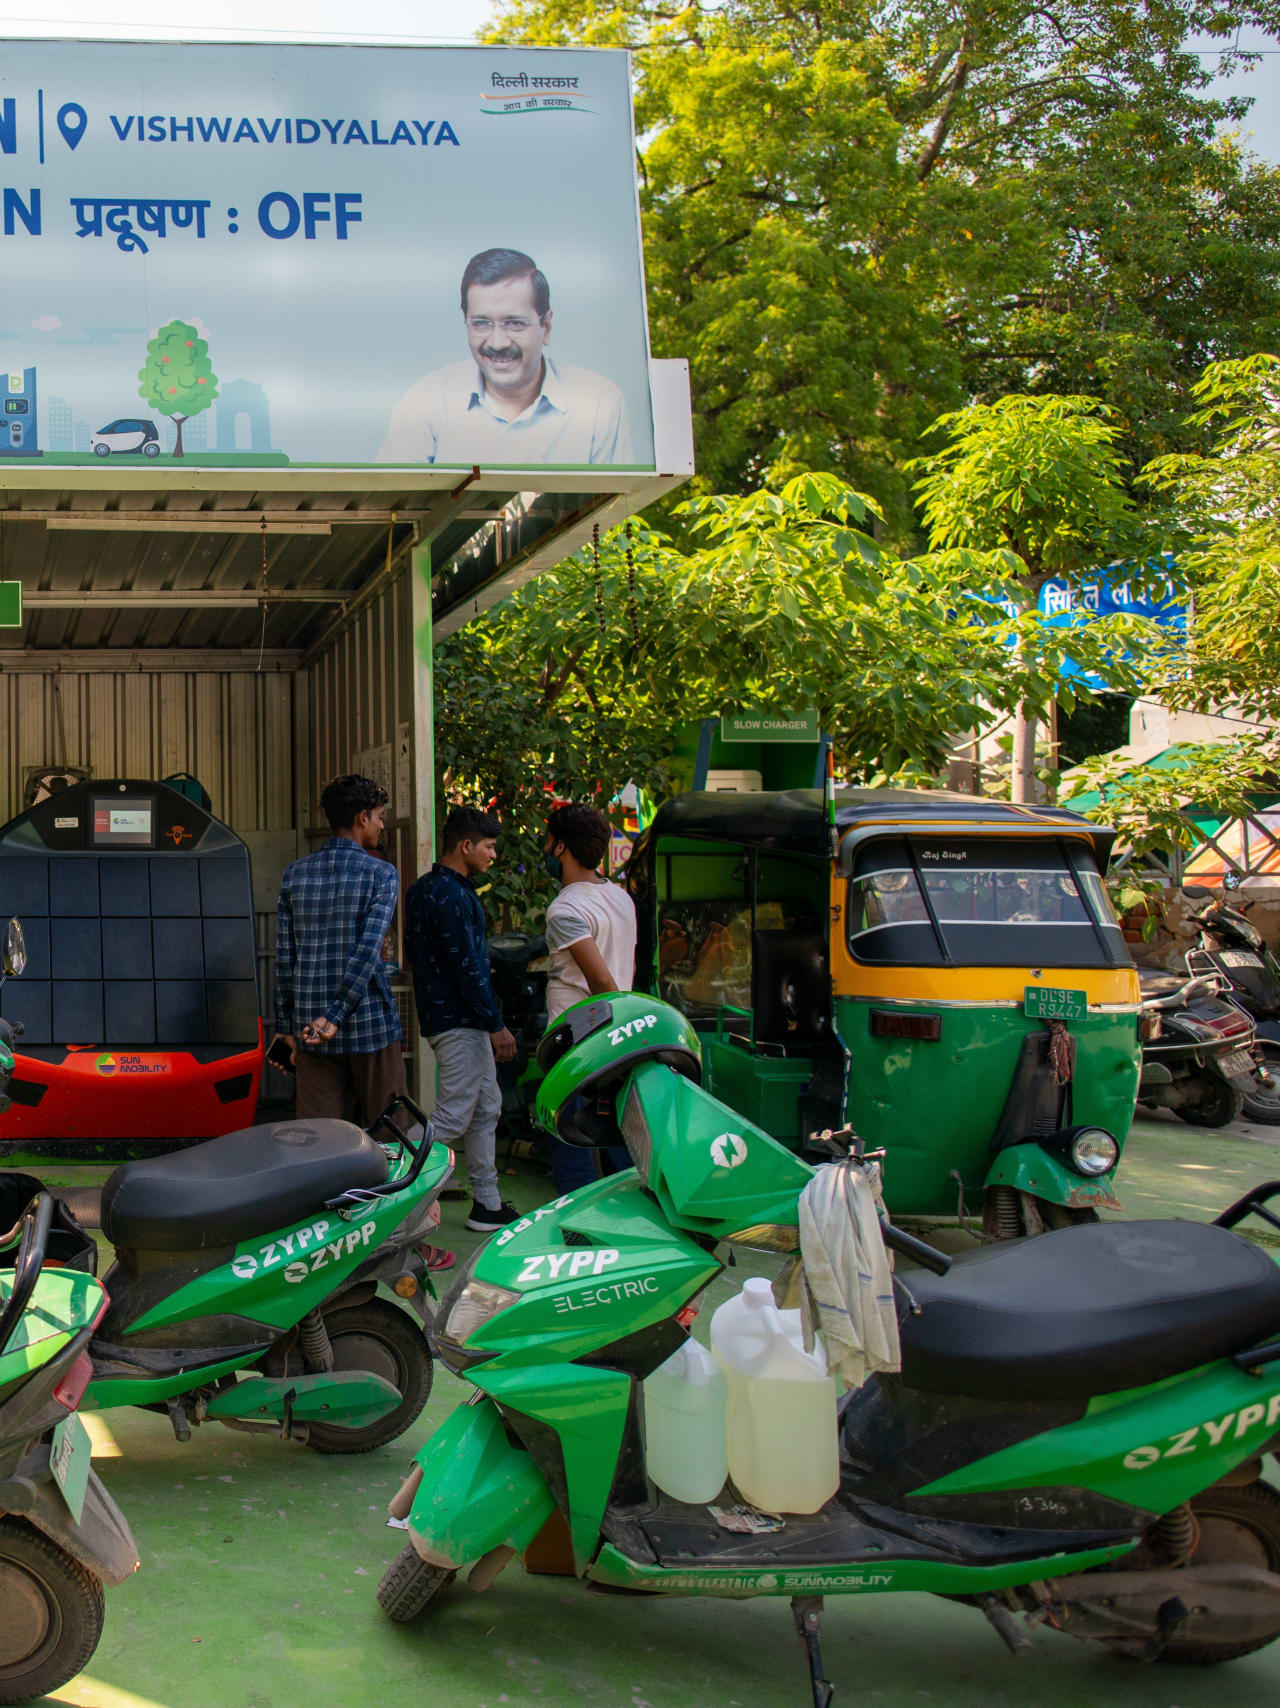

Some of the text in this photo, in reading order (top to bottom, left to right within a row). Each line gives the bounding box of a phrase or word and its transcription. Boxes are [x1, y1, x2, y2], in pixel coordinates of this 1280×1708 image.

[491, 72, 579, 88] दिल्ली सरकार
[110, 115, 460, 147] VISHWAVIDYALAYA
[71, 197, 210, 254] प्रदूषण
[257, 191, 363, 240] OFF
[734, 720, 807, 730] SLOW CHARGER
[607, 1014, 658, 1046] ZYPP
[120, 1056, 141, 1065] SUN
[120, 1065, 167, 1073] MOBILITY
[260, 1220, 329, 1268] ZYPP
[311, 1221, 376, 1272] ZYPP
[517, 1250, 619, 1282] ZYPP
[553, 1277, 659, 1313] ELECTRIC
[784, 1575, 892, 1587] SUNMOBILITY
